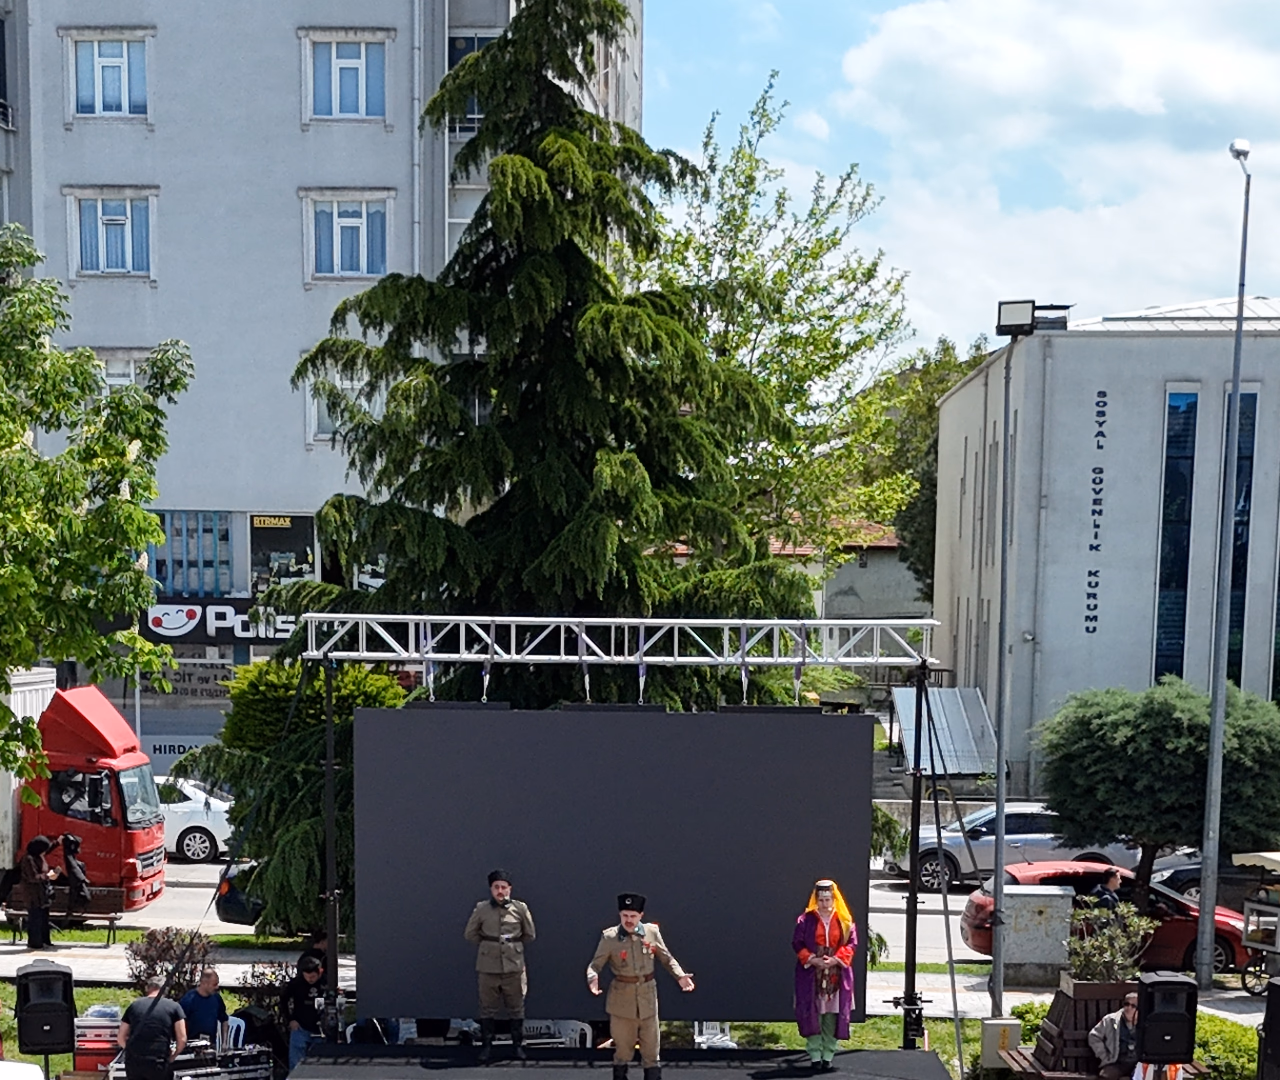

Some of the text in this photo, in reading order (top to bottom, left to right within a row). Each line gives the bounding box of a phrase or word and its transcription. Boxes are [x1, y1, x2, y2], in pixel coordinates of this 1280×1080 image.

[1094, 390, 1108, 450] SOSYAL
[253, 516, 292, 528] RTRMAX
[1084, 569, 1101, 634] KURUMU
